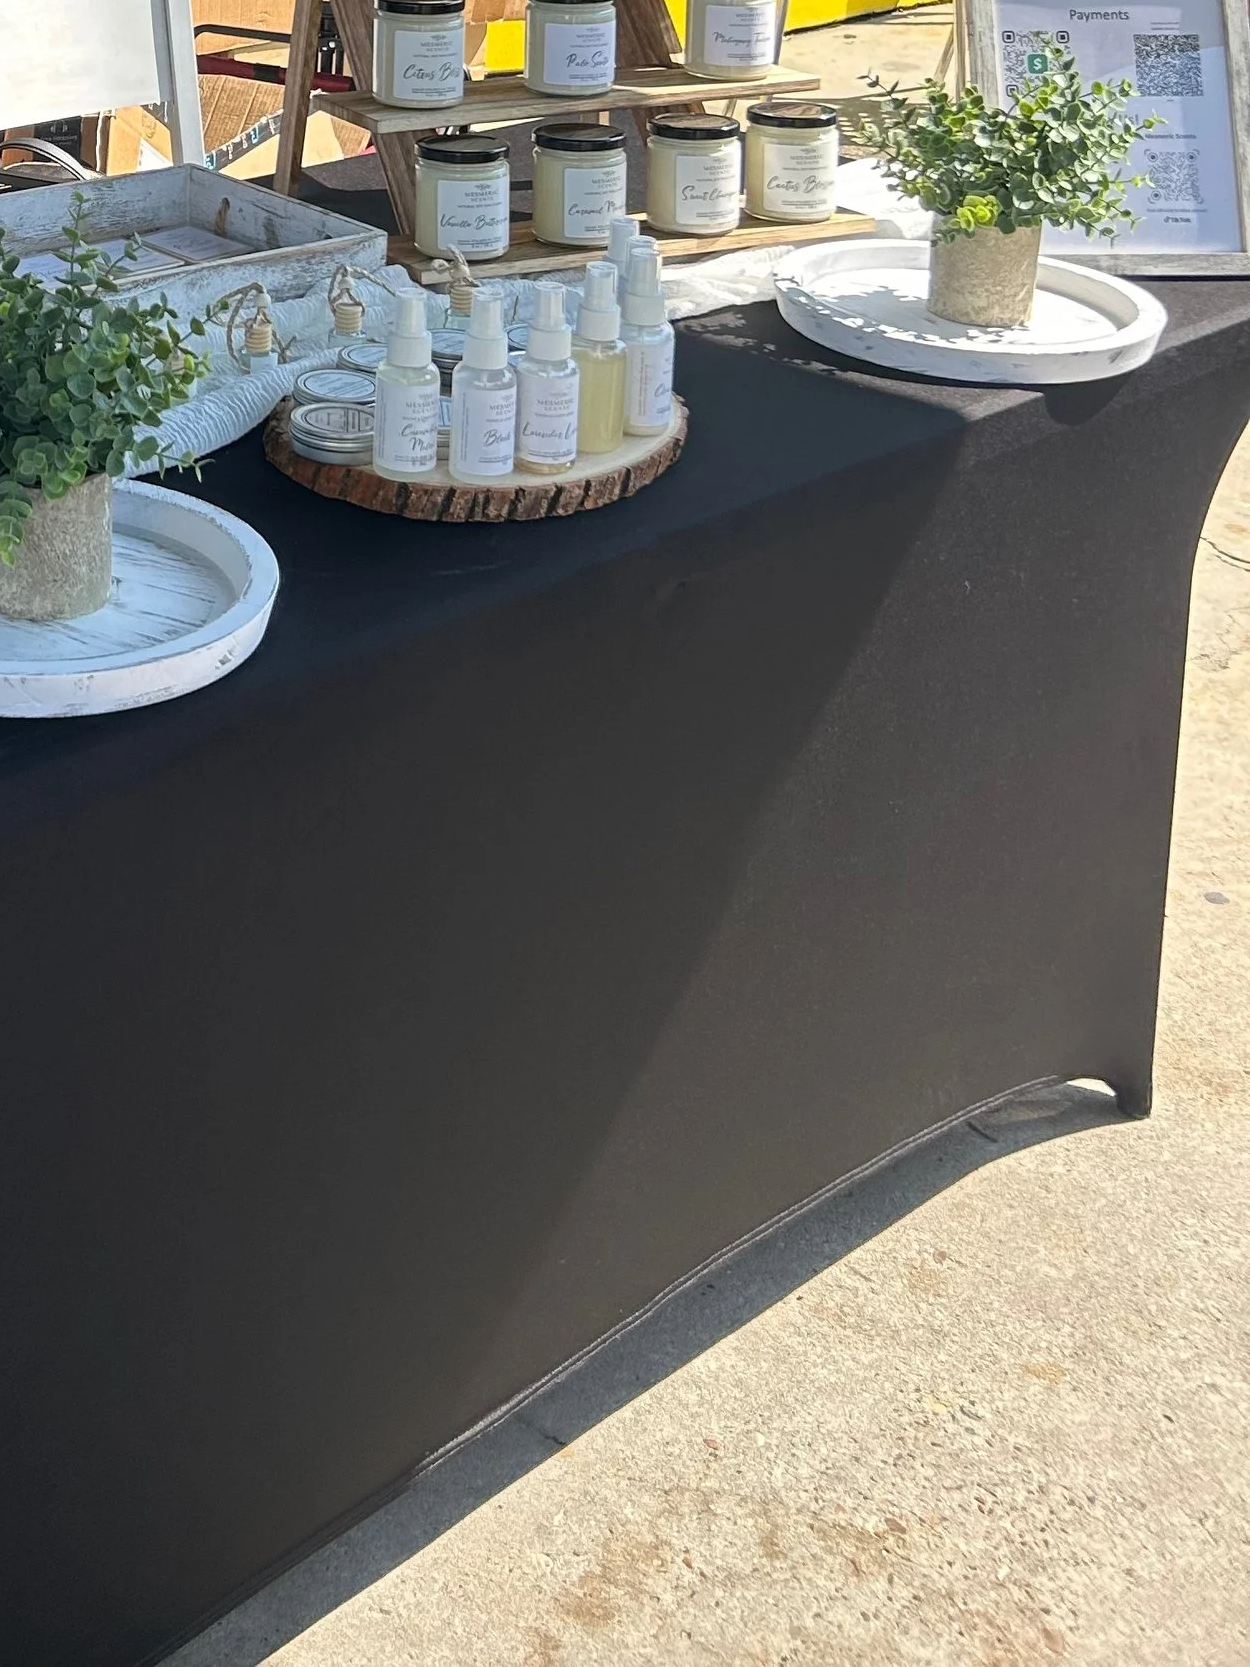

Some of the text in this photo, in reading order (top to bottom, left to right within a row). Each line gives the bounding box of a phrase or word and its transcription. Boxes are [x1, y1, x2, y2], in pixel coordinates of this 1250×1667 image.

[1069, 9, 1129, 23] Payments
[402, 63, 436, 80] Citrus
[766, 176, 800, 192] Cactus
[440, 213, 472, 228] Vanilla
